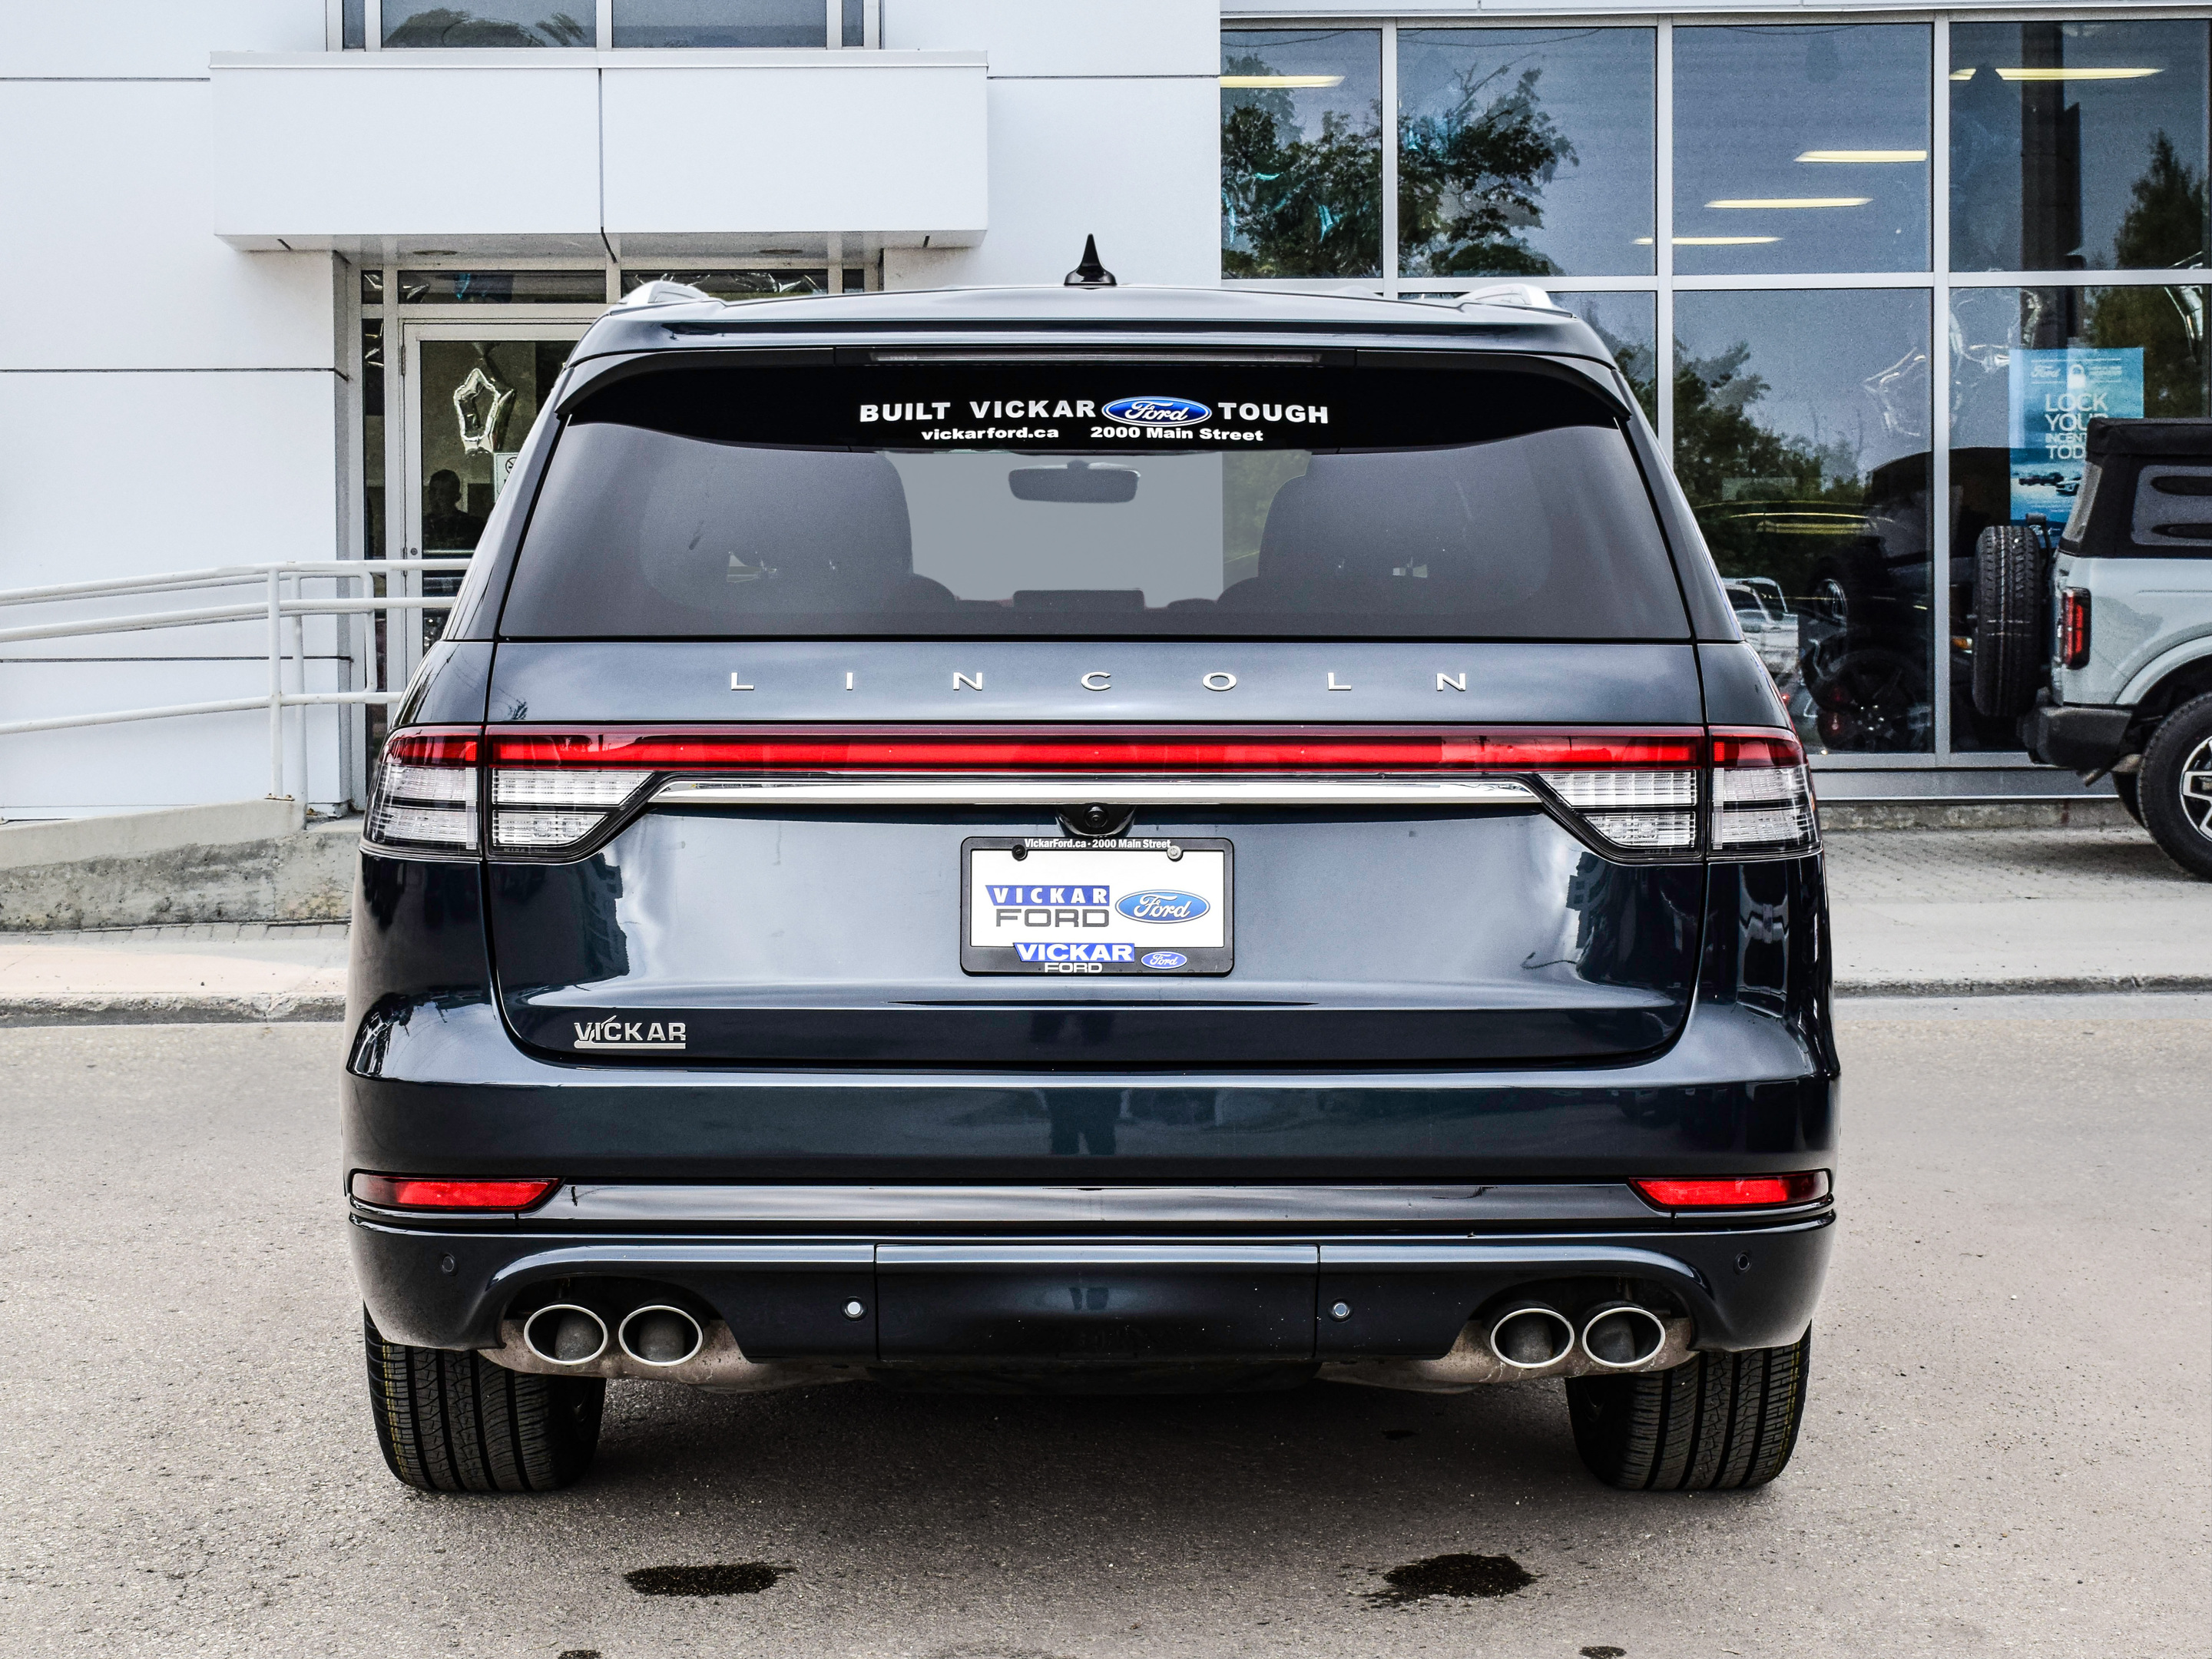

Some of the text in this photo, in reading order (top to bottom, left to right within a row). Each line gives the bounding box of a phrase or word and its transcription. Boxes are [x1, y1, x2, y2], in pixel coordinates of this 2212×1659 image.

[2045, 392, 2108, 412] LOCK
[859, 400, 1329, 424] BUILT VICKAR Ford TOUGH
[2045, 412, 2108, 431] YOU
[921, 426, 1263, 442] vickarford.ca 2000 Main Street
[730, 671, 1466, 691] LINCOLN
[1092, 839, 1117, 848] 2000
[1118, 839, 1141, 848] Main
[1142, 839, 1171, 849] Street
[993, 887, 1108, 904] VICKAR
[1133, 893, 1192, 918] Ford
[995, 909, 1109, 928] FORD
[1017, 944, 1132, 961] VICKAR
[1149, 952, 1178, 965] Ford
[1044, 962, 1103, 973] FORD
[574, 1022, 686, 1041] VICKAR
